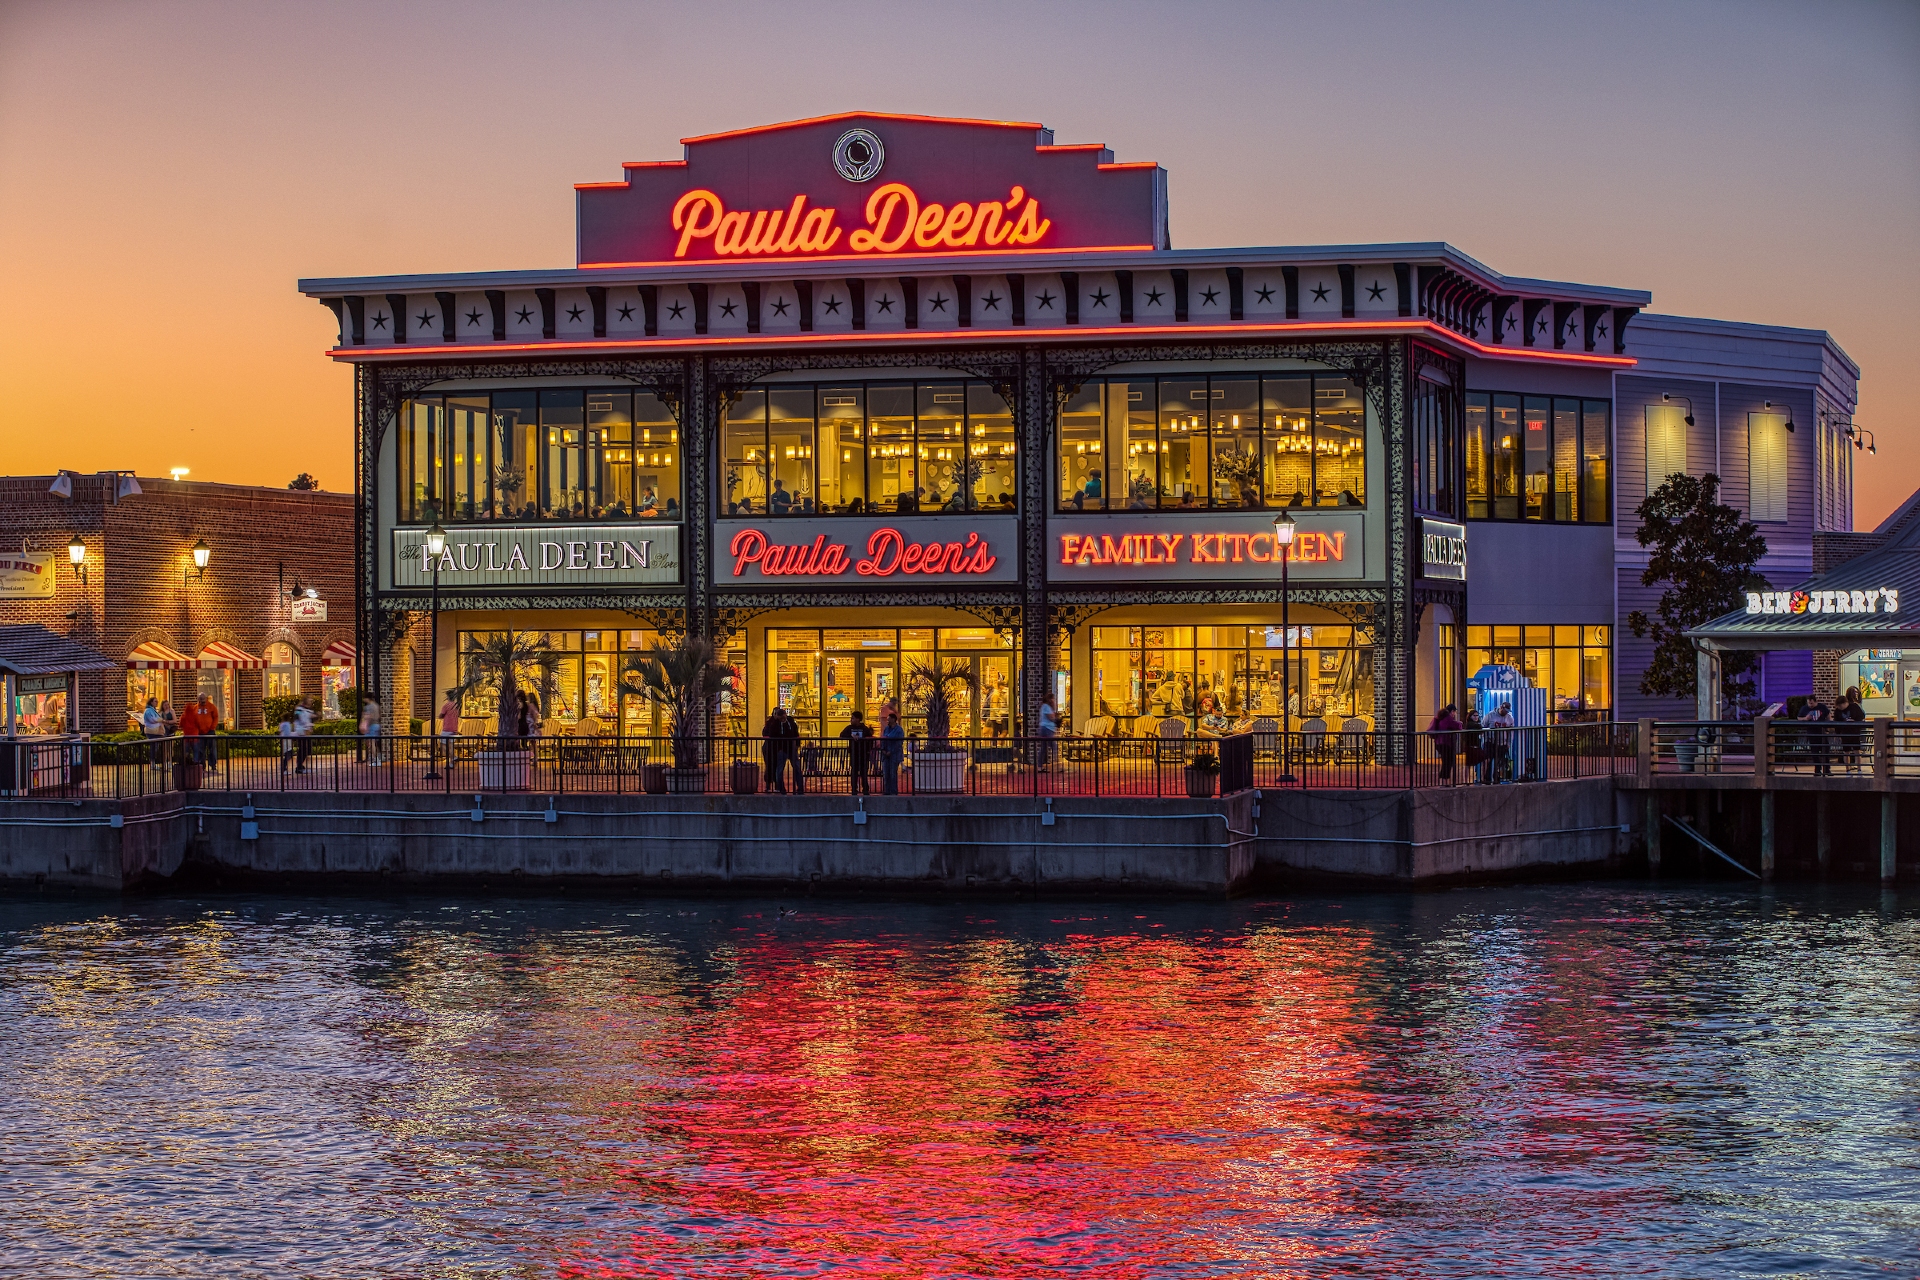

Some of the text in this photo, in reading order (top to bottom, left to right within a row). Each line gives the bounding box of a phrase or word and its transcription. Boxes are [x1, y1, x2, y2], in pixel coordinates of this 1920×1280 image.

[673, 183, 1051, 258] Paula Deen's
[399, 544, 421, 560] The
[539, 540, 653, 571] DEEN
[651, 553, 679, 569] Store
[730, 527, 997, 577] Paula Deen's
[1061, 532, 1346, 565] FAMILY KITCHEN
[1746, 592, 1790, 614] BEN
[1809, 587, 1898, 613] JERRY'S
